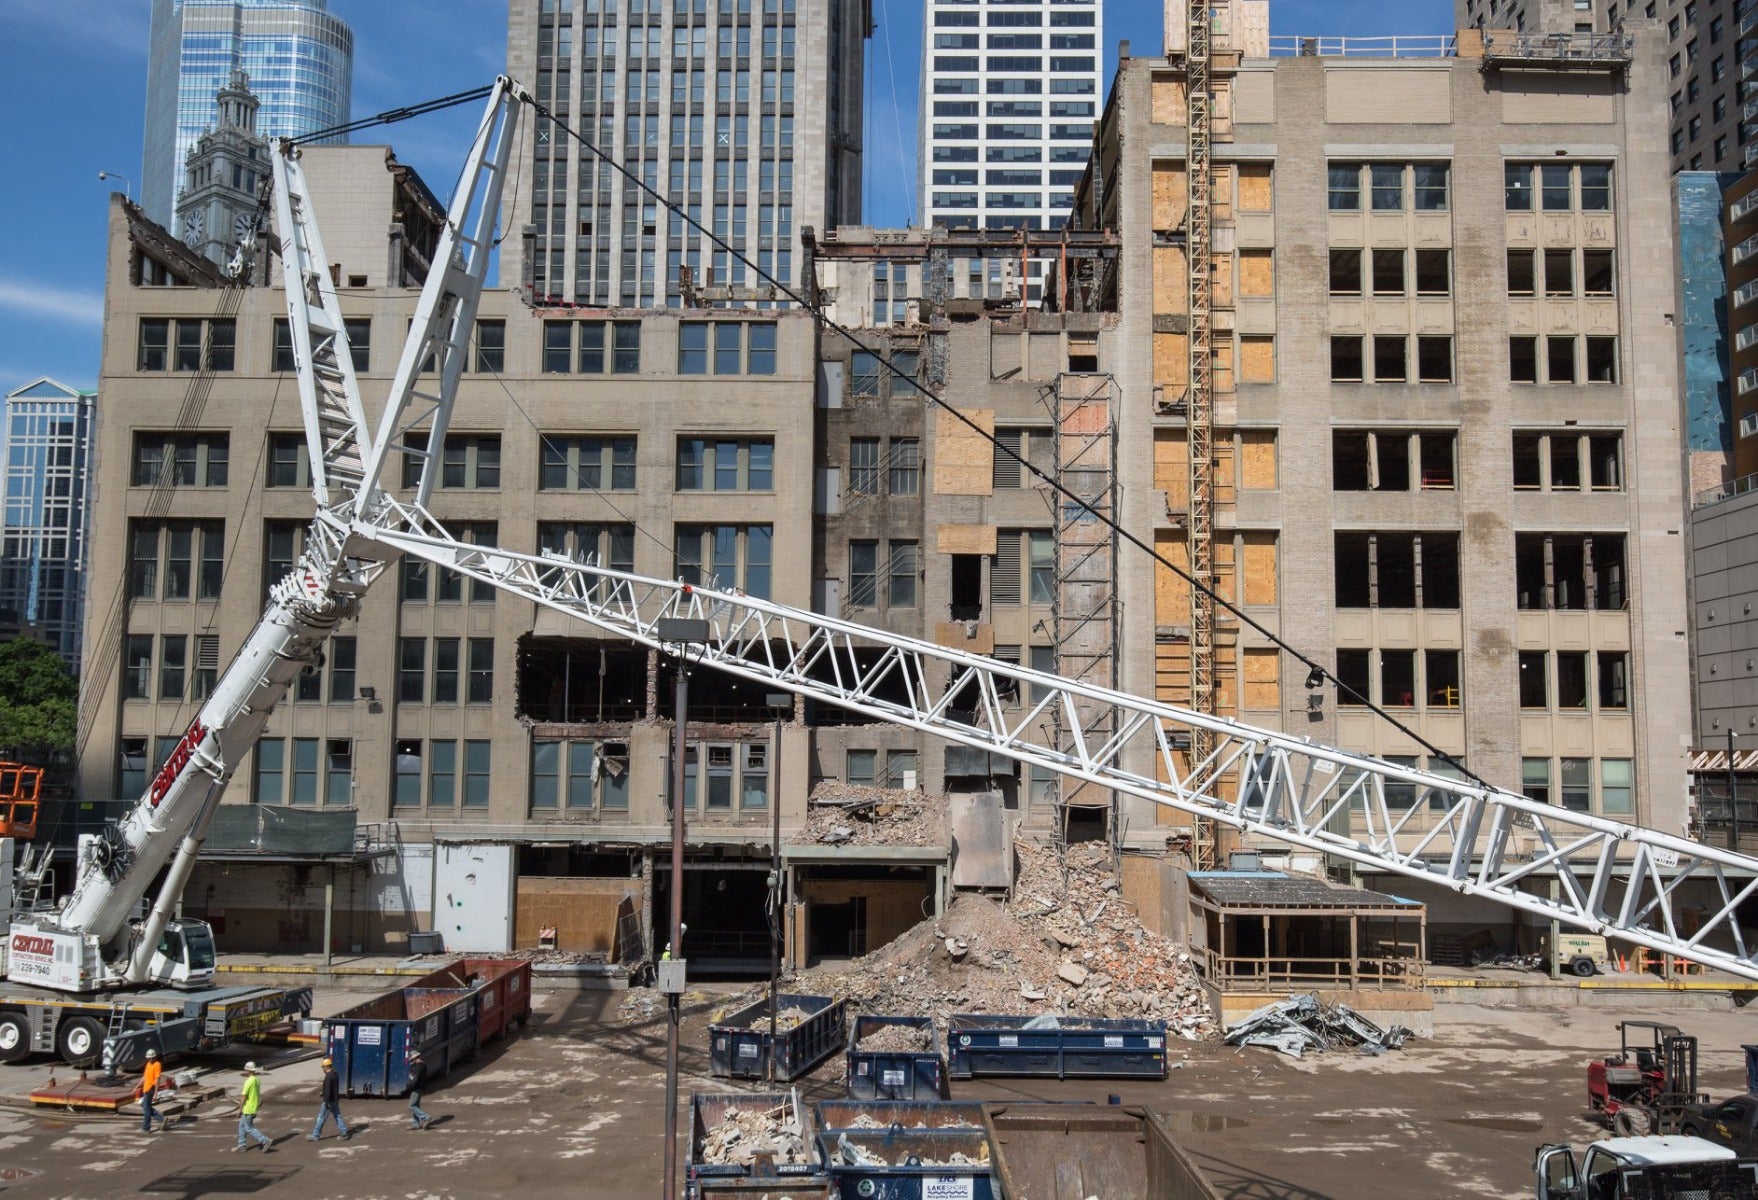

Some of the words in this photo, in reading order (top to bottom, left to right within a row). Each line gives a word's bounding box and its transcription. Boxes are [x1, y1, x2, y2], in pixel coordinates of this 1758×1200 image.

[150, 716, 209, 808] CENTRAL
[12, 934, 54, 956] CENTRAL
[21, 963, 50, 975] 239-7940
